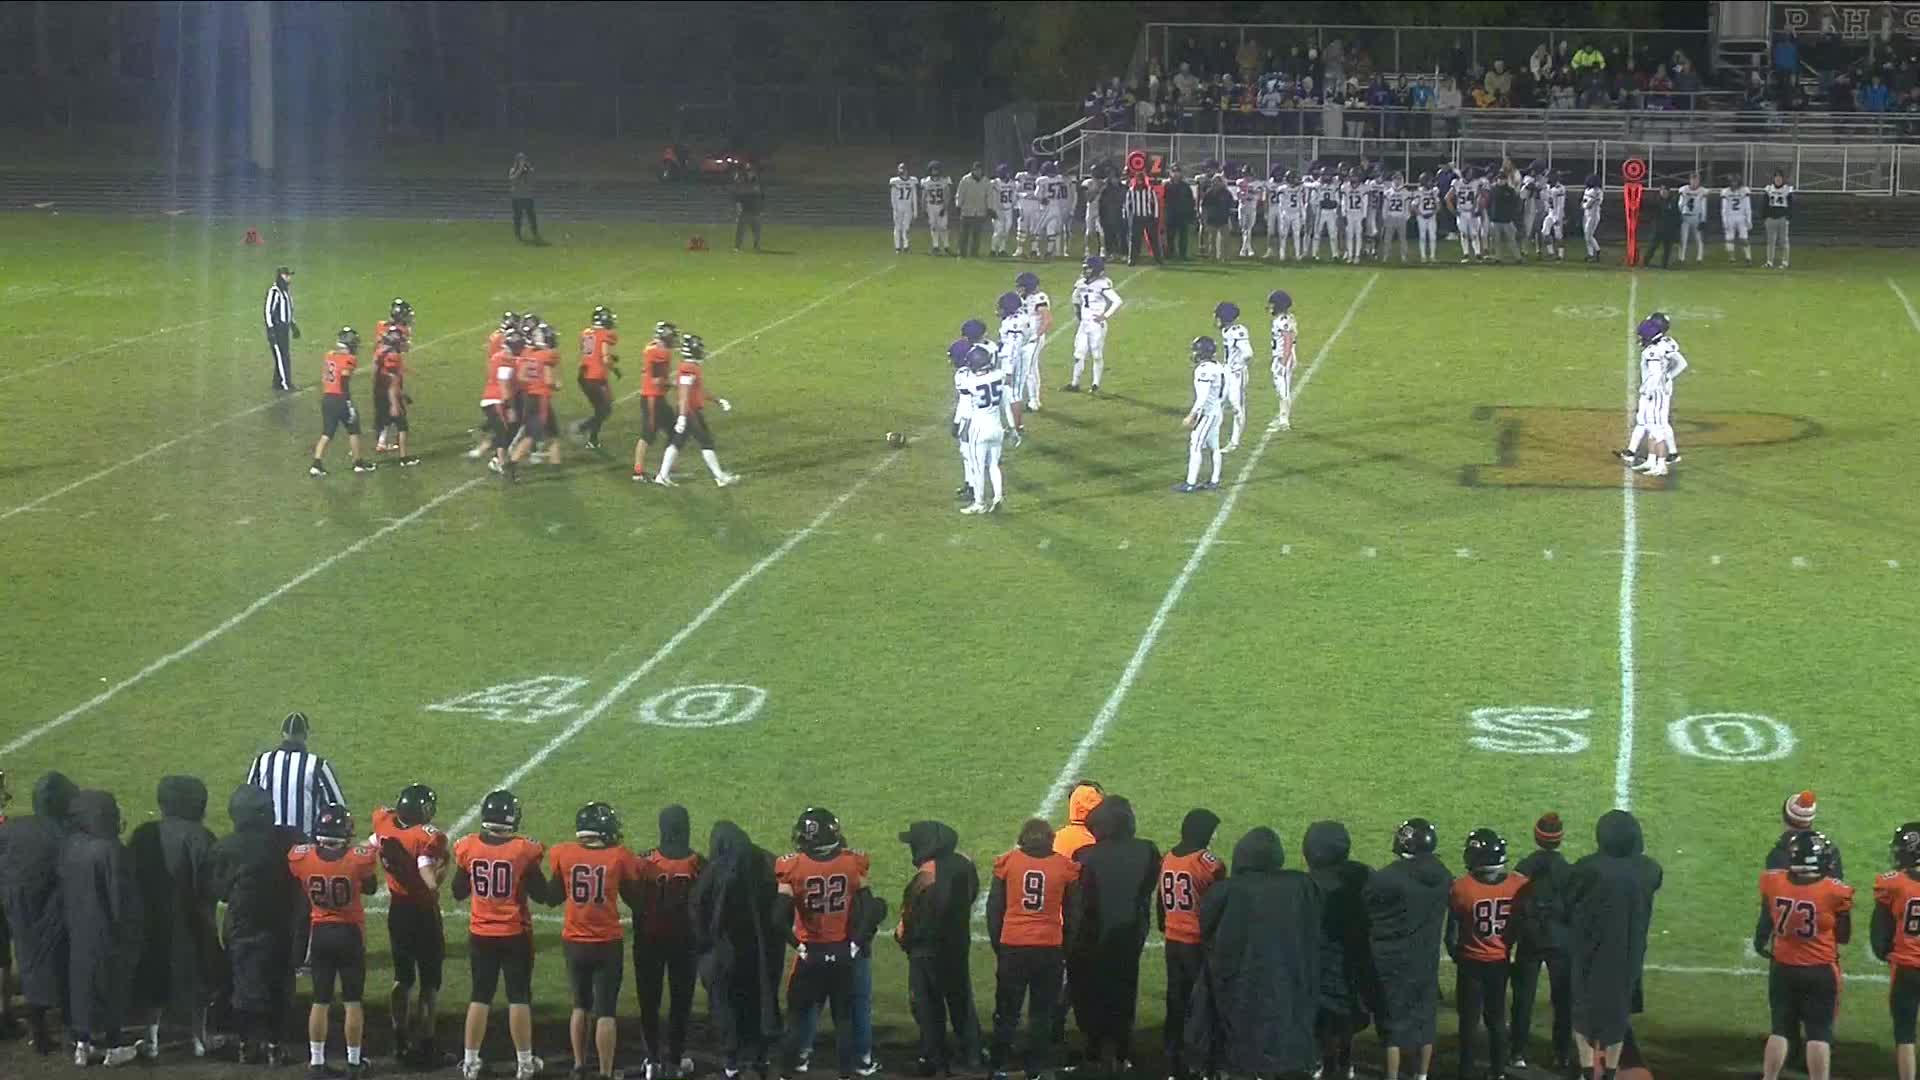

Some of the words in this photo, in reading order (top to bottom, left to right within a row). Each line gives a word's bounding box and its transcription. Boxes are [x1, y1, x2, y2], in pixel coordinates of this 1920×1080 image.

[898, 187, 911, 201] 17
[976, 380, 1003, 409] 35
[307, 873, 353, 909] 20
[470, 858, 514, 899] 60
[569, 863, 606, 905] 61
[805, 874, 848, 913] 22
[1021, 869, 1046, 912] 9
[1161, 870, 1195, 912] 83
[1472, 897, 1512, 938] 85
[1775, 896, 1816, 939] 73
